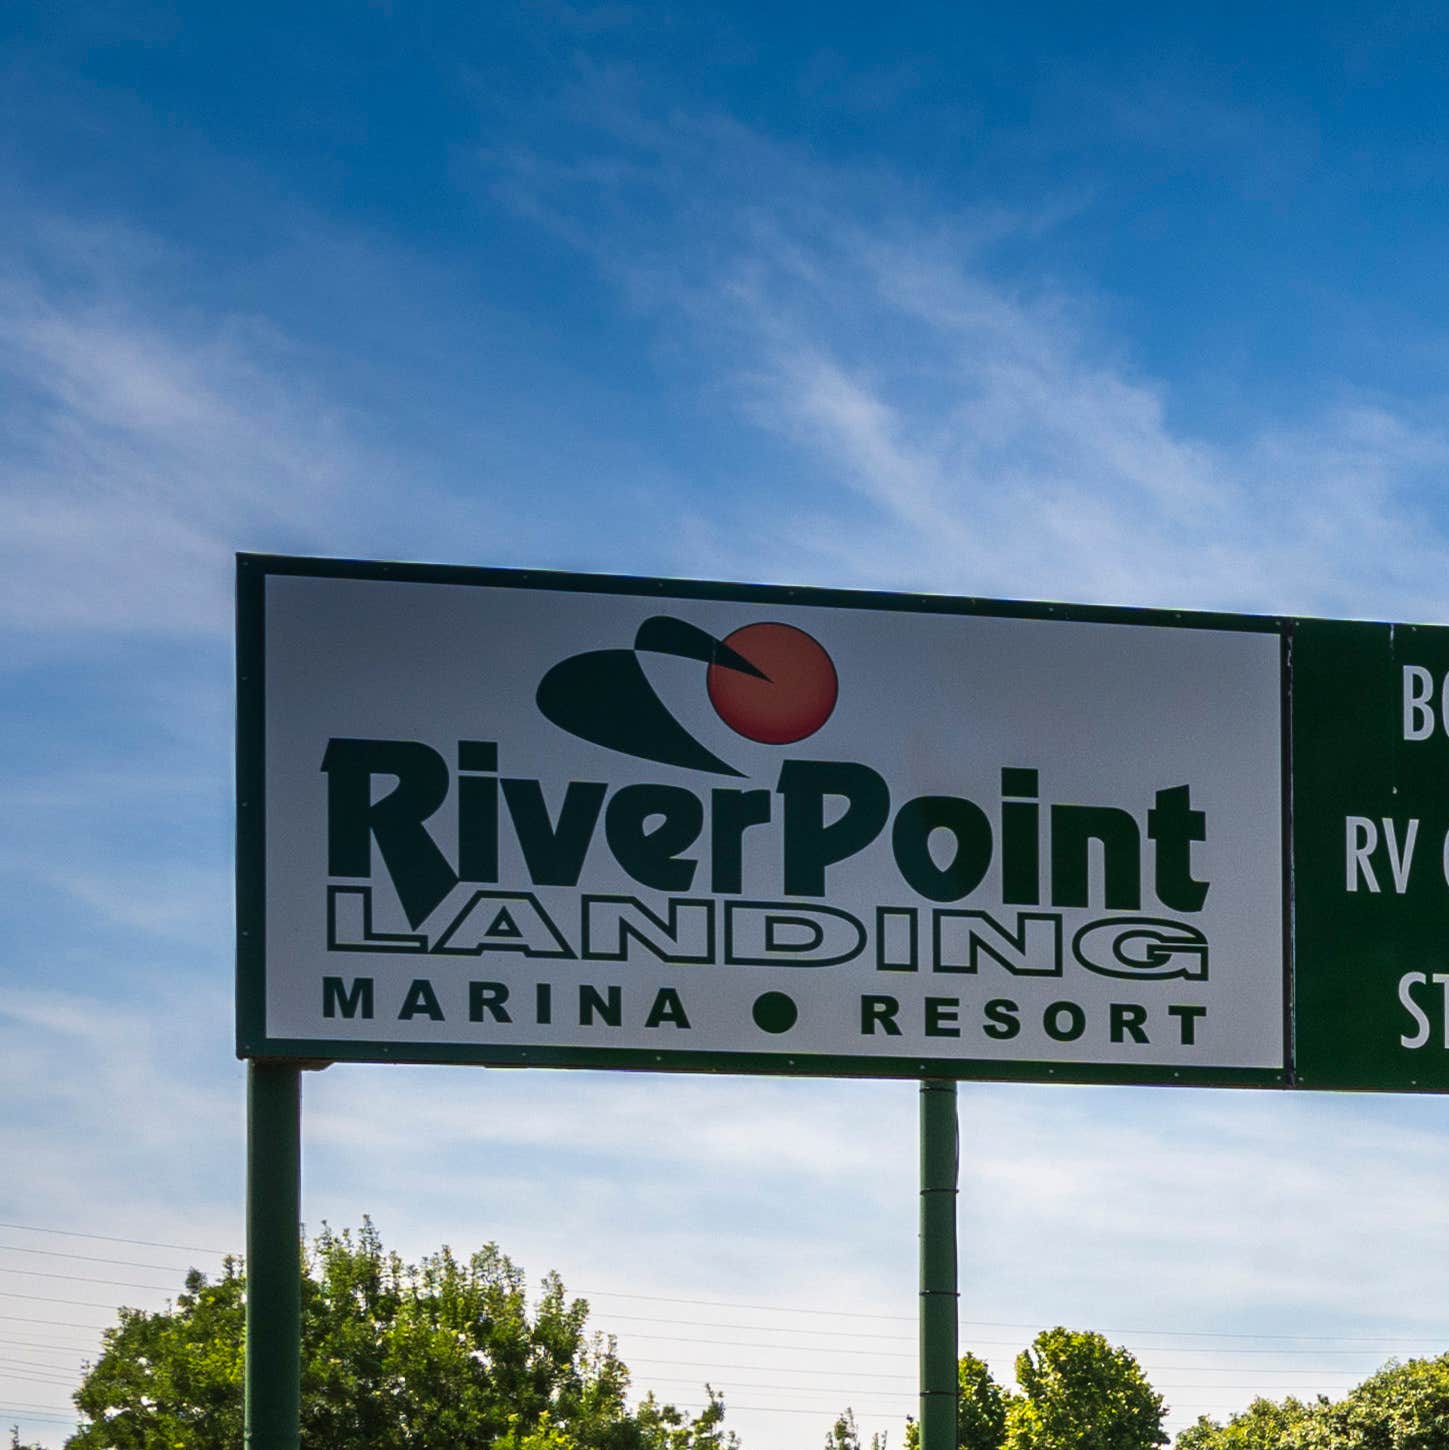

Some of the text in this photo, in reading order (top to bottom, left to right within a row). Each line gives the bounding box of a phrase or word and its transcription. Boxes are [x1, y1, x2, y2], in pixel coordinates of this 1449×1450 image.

[320, 738, 1210, 931] RiverPoint
[1345, 816, 1419, 894] RV
[327, 885, 1209, 981] LANDING
[321, 976, 1207, 1045] MARINA RESORT
